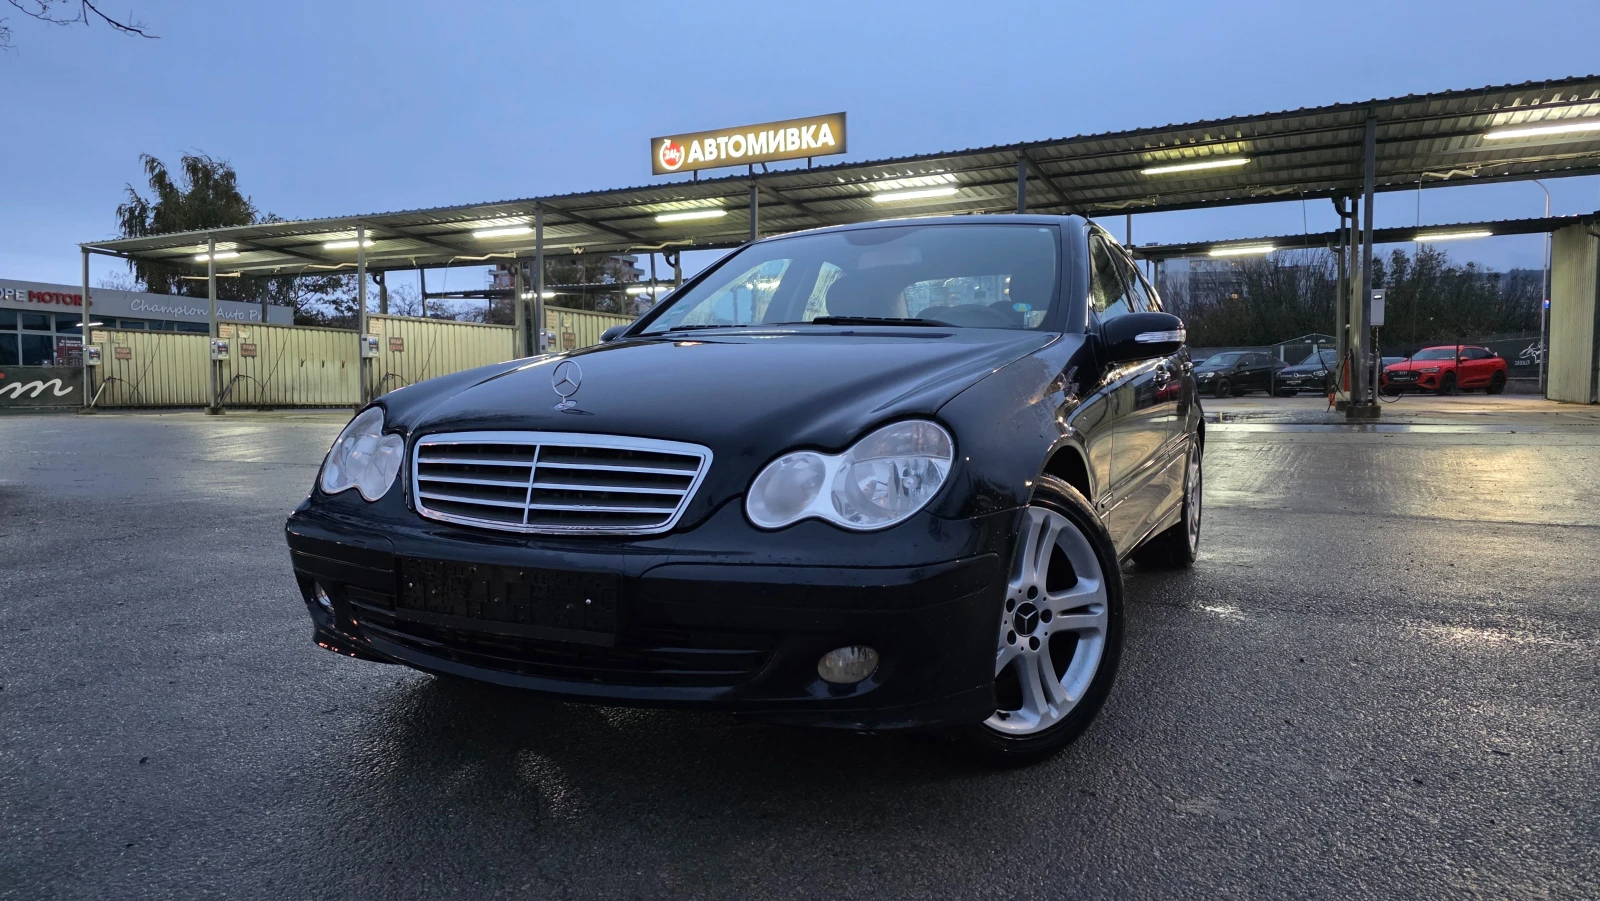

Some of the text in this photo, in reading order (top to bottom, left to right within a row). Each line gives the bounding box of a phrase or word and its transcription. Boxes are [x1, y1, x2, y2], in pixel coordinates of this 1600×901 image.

[687, 122, 836, 164] АВТОМИВКА
[130, 298, 208, 318] Champion
[216, 308, 245, 320] Auto
